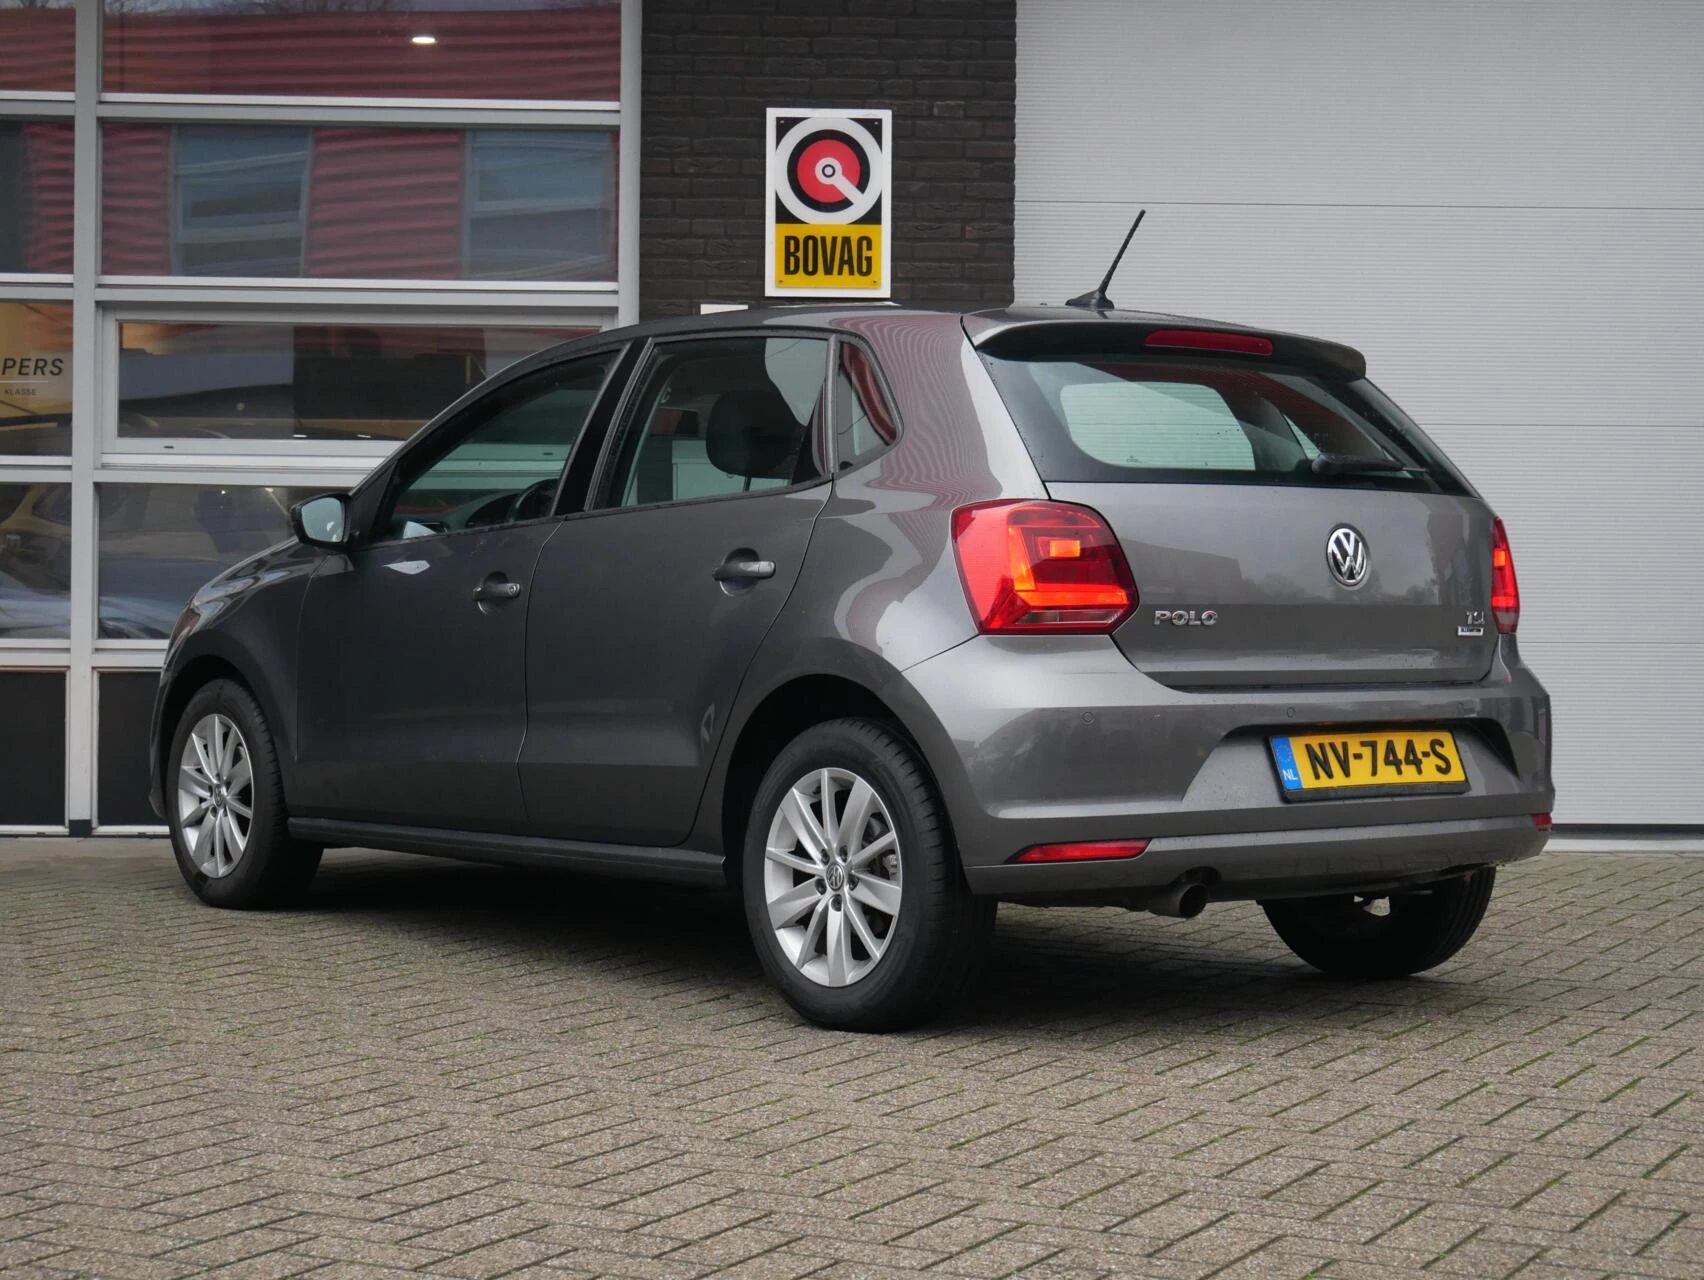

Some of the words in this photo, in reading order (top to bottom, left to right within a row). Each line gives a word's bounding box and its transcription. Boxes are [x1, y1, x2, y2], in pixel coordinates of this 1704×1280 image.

[784, 235, 873, 277] BOVAG
[1, 357, 64, 376] PERS
[1154, 610, 1218, 626] POLO
[1282, 769, 1298, 781] NL
[1305, 738, 1452, 780] NV-744-S
